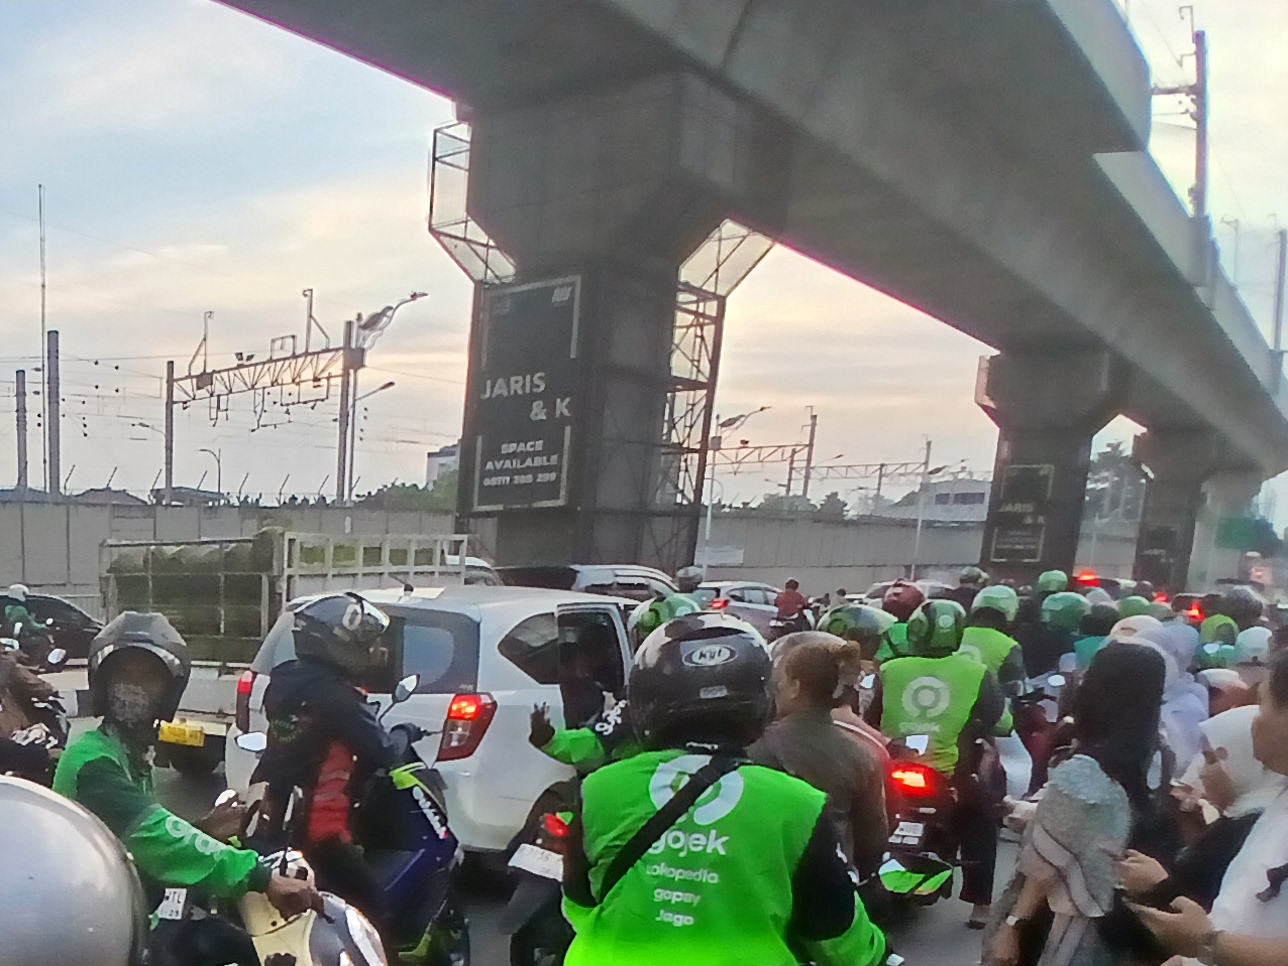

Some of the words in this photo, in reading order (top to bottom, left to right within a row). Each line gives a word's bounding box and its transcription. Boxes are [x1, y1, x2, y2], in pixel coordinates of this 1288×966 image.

[480, 371, 546, 400] JARIS
[530, 400, 547, 421] &
[555, 396, 572, 419] K
[501, 440, 544, 454] SPACE
[484, 454, 559, 471] AVAILABLE
[647, 829, 730, 857] gojek
[653, 887, 701, 907] gopay
